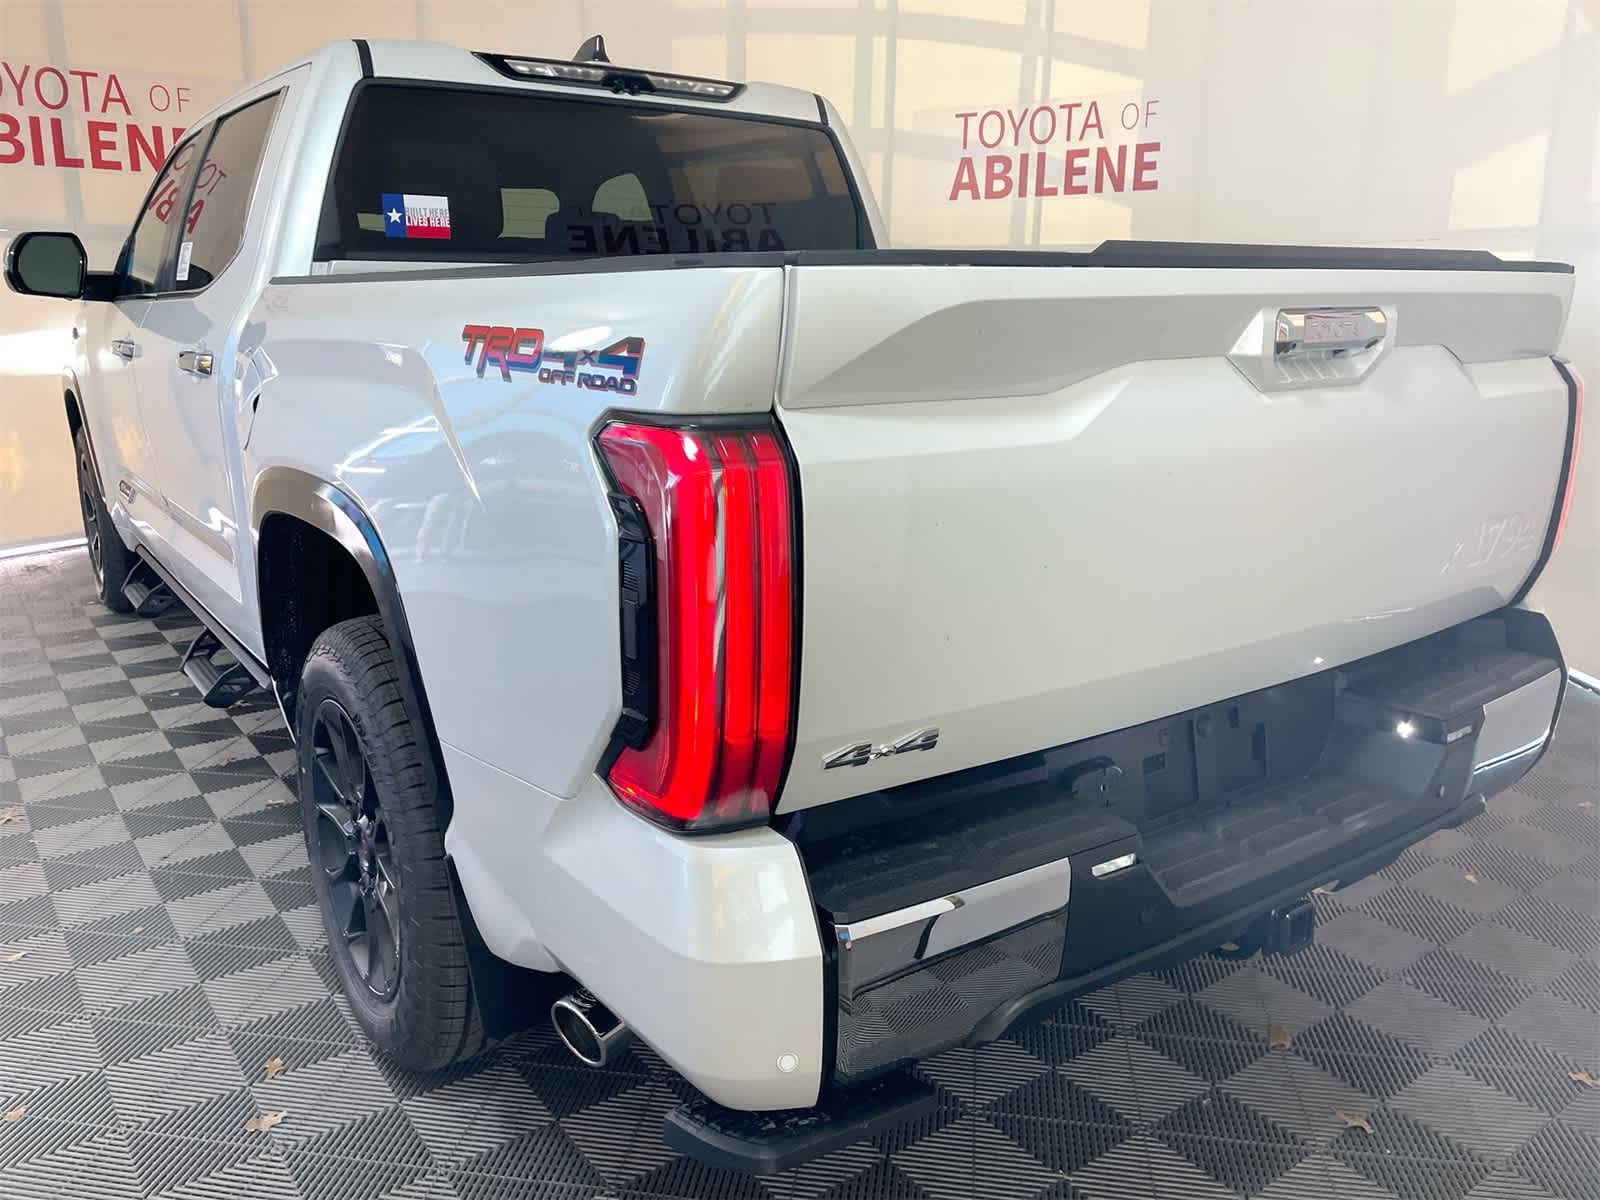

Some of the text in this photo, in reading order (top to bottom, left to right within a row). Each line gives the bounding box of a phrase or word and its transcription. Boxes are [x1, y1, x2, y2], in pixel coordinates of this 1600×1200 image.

[0, 62, 192, 116] YOTA OF
[955, 100, 1160, 150] TOYOTA OF
[949, 142, 1161, 201] ABILENE
[405, 215, 450, 228] LIVES HERE
[428, 208, 449, 218] HERE
[462, 324, 545, 384] TRD
[537, 367, 639, 397] OFF ROAD
